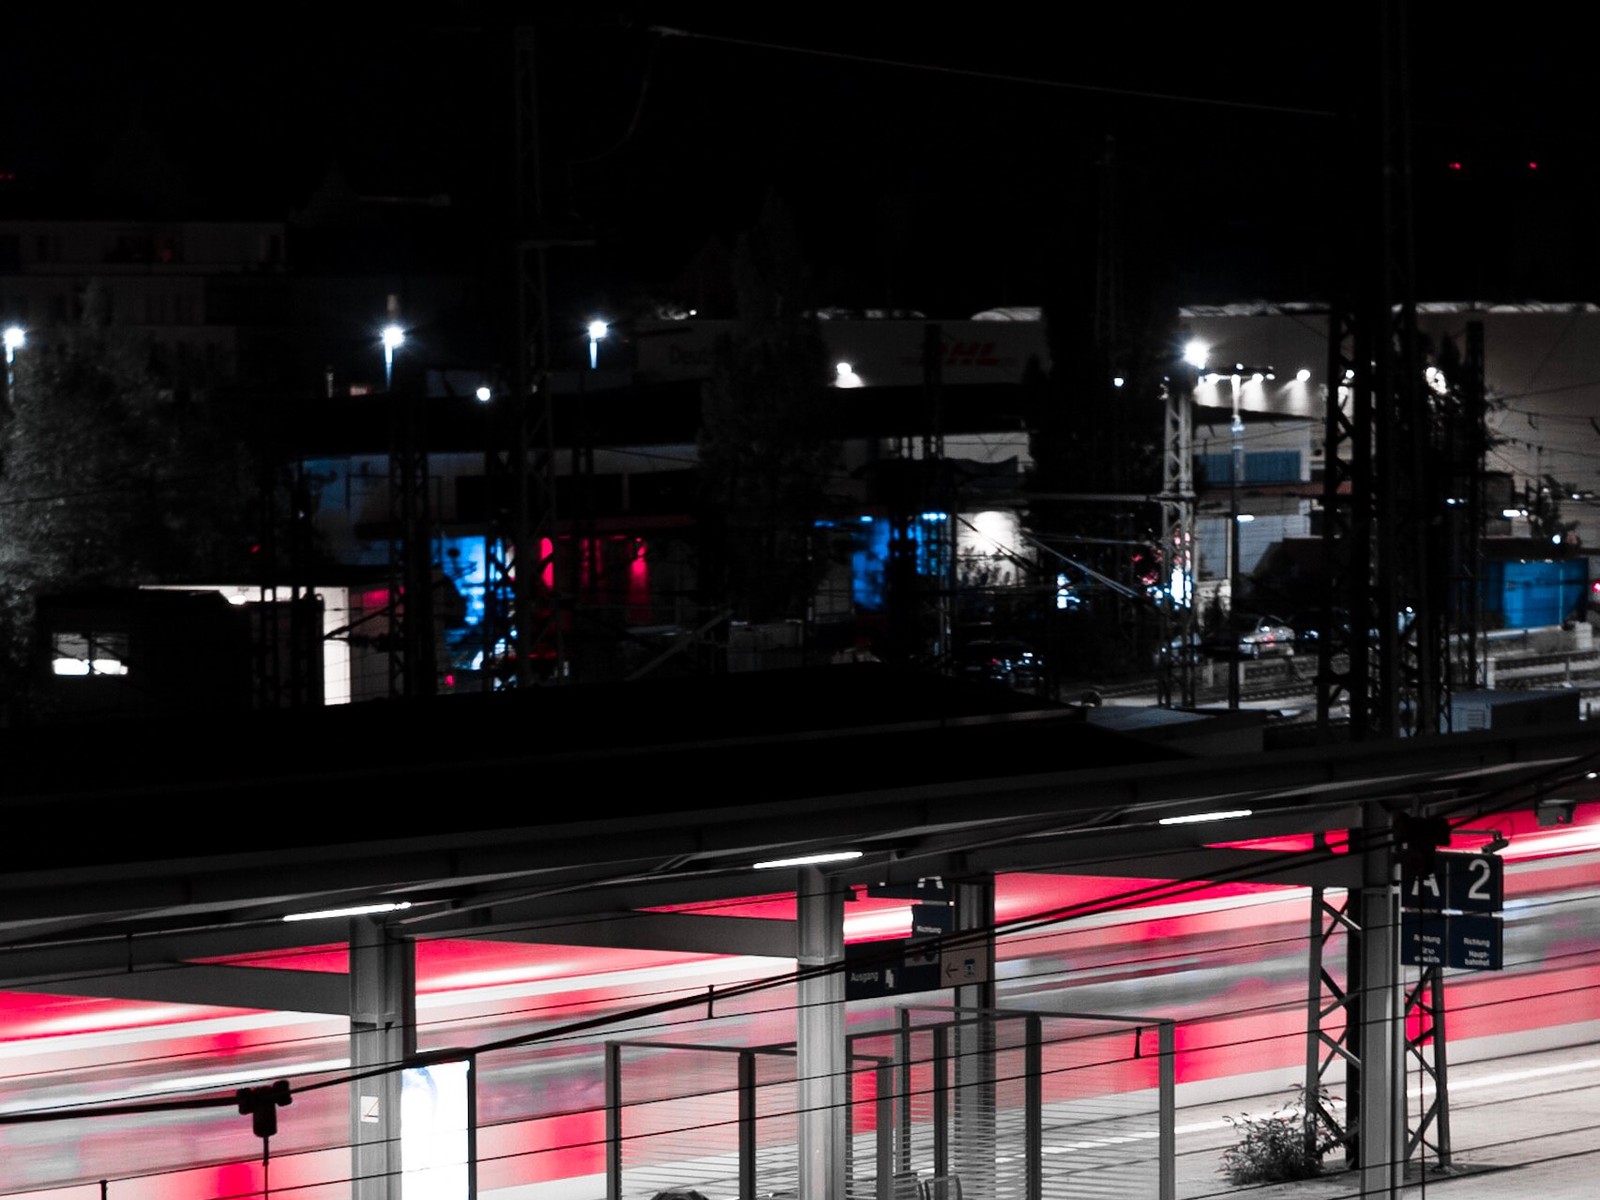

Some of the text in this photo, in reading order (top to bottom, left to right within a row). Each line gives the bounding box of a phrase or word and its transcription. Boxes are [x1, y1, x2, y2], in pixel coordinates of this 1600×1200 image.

[1468, 858, 1491, 900] 2
[1413, 934, 1441, 945] Rihtung
[1463, 937, 1491, 948] Richtung
[1464, 958, 1490, 967] bahnhof
[850, 972, 879, 983] Ausgang
